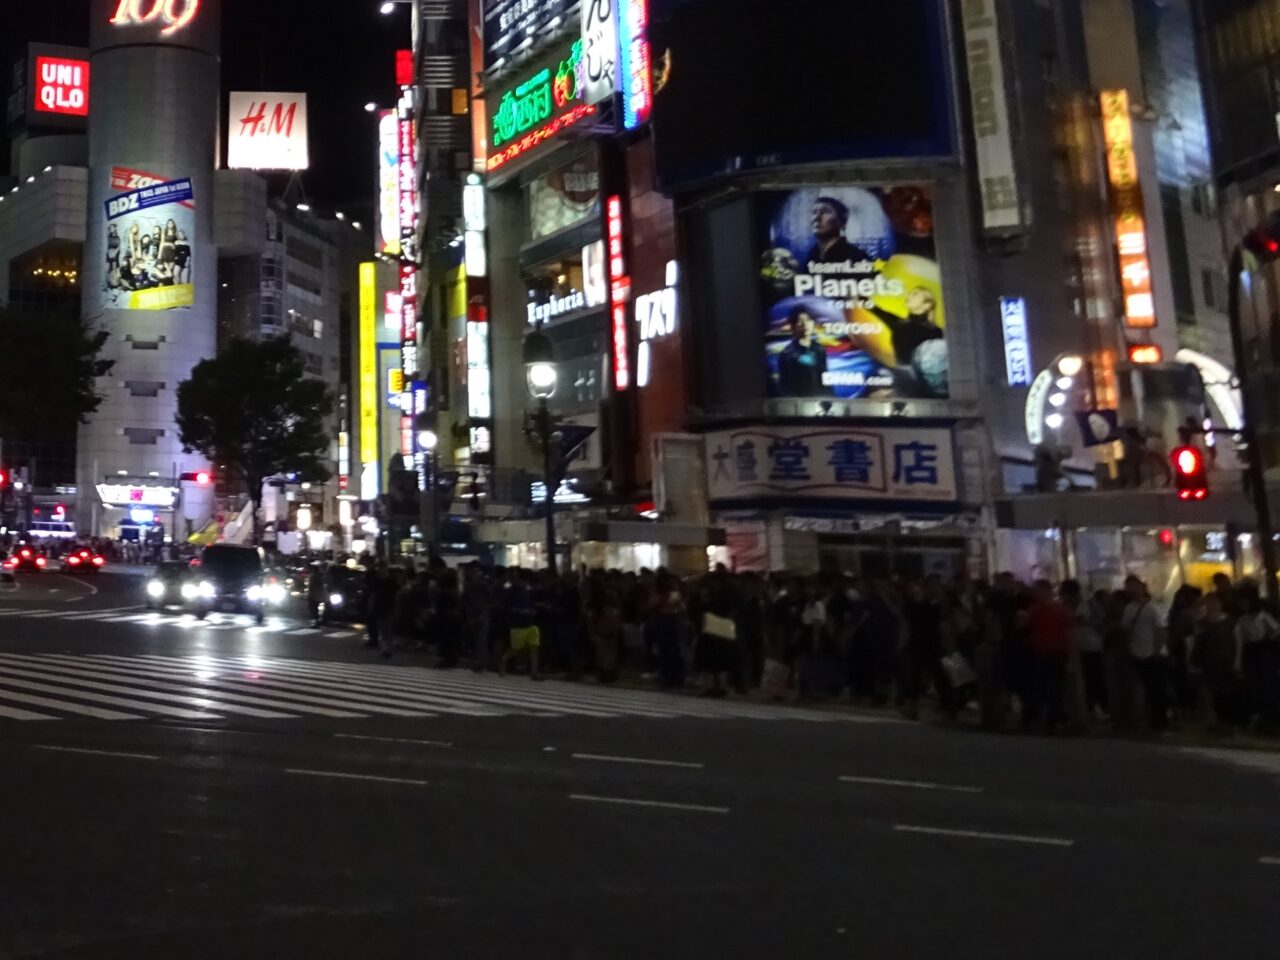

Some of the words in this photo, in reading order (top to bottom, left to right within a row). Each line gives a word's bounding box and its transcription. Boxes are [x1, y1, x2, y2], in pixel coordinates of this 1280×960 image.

[41, 63, 81, 87] UNI
[40, 88, 84, 108] QLO
[240, 101, 297, 138] H&M
[794, 273, 904, 298] Planets
